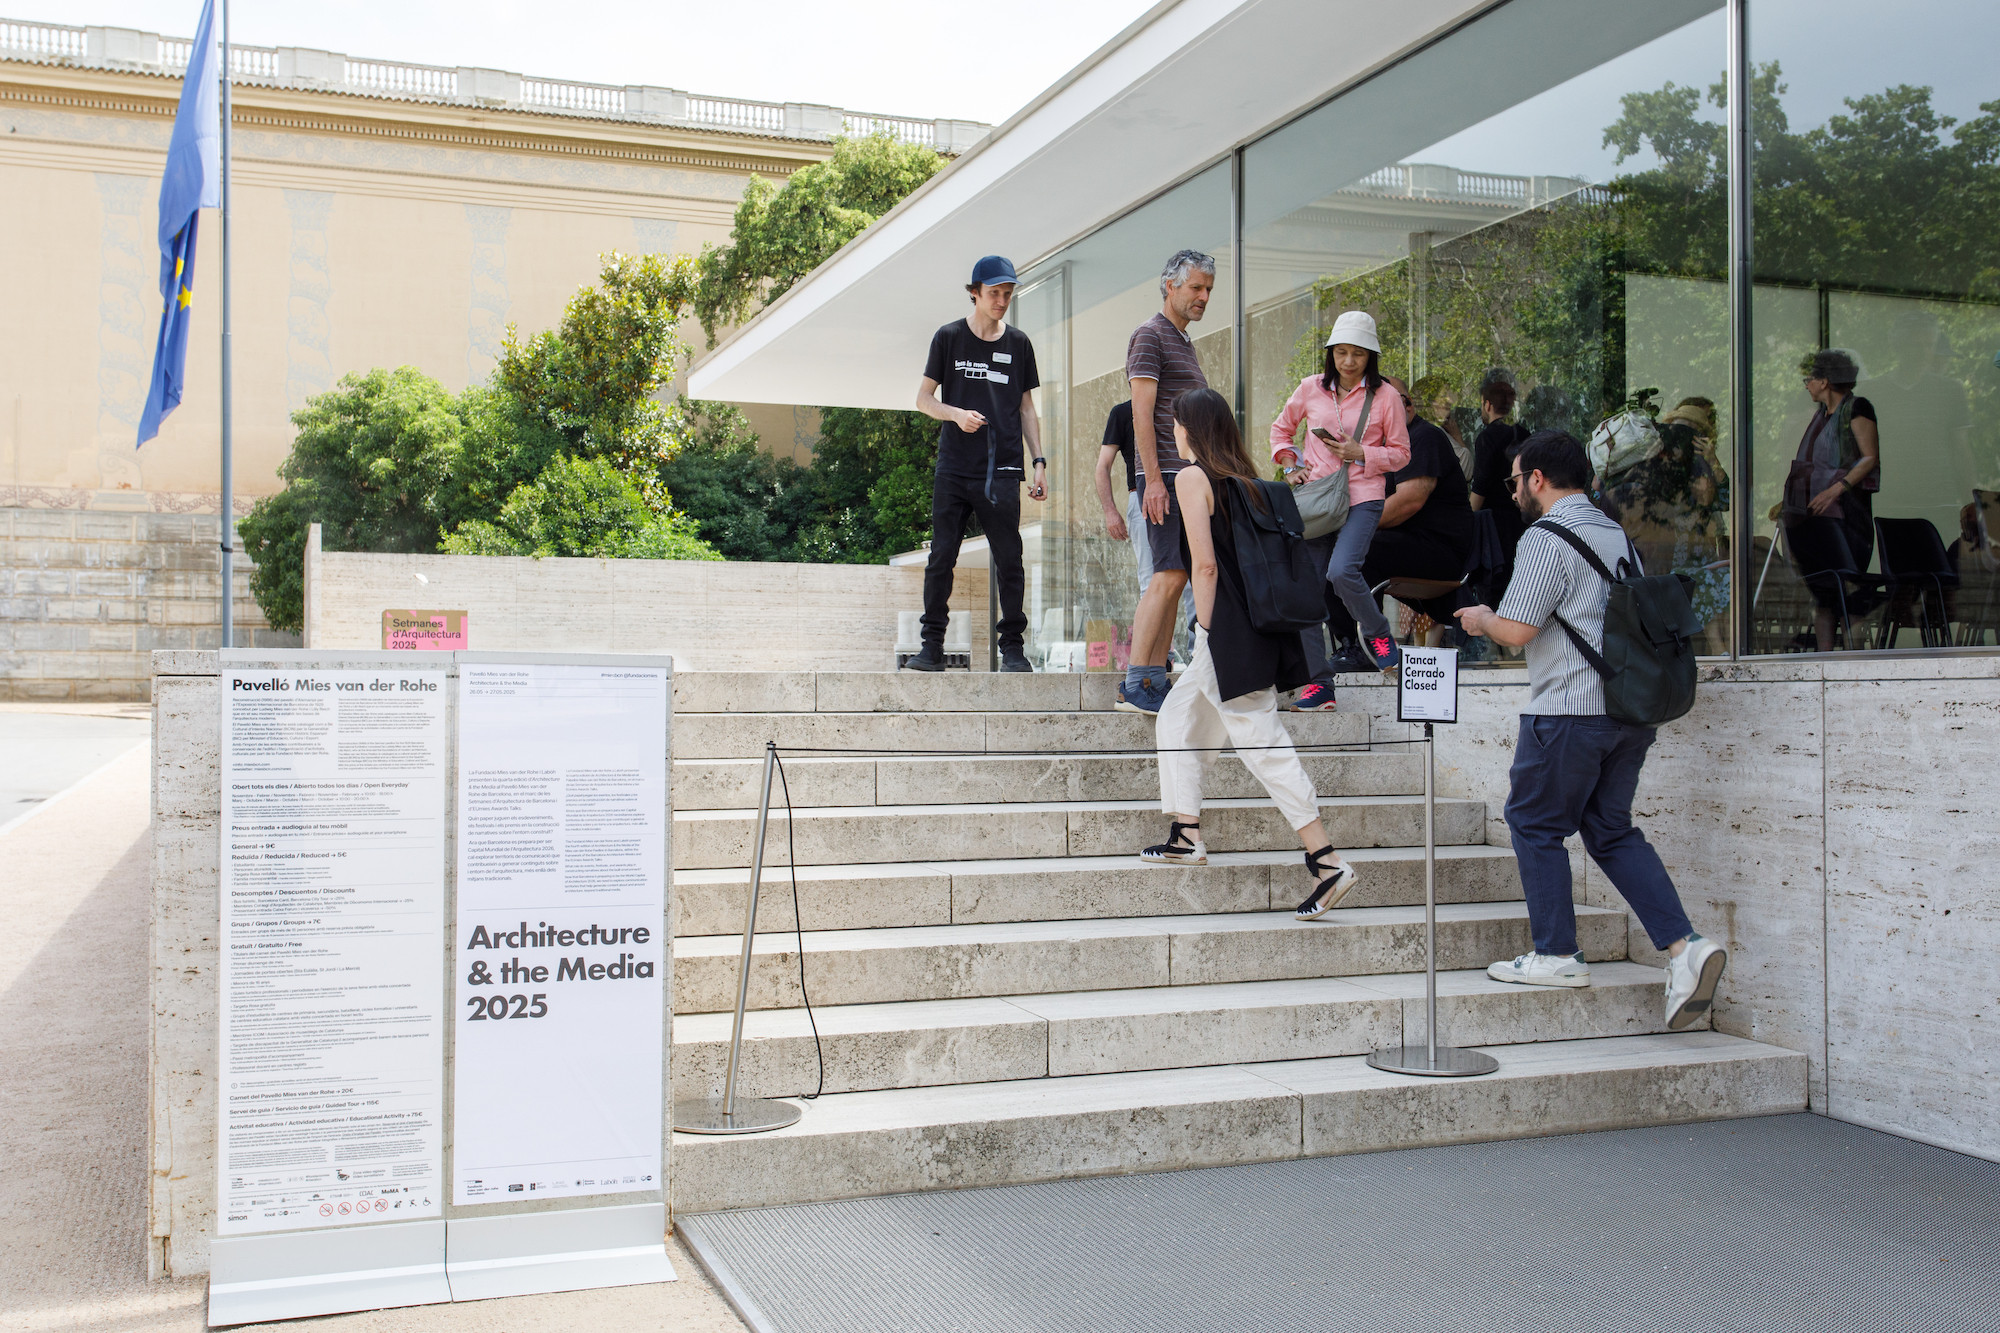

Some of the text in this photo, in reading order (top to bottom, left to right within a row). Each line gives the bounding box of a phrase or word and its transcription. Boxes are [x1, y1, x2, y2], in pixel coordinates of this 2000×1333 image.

[392, 618, 443, 628] Setmanes
[392, 630, 461, 640] d'Arquitectura
[392, 641, 417, 649] 2025
[1405, 654, 1437, 665] Tancat
[1405, 667, 1445, 678] Cerrado
[233, 678, 437, 692] Pavelló Mies van der Rohe
[1405, 679, 1437, 690] Closed
[467, 922, 650, 950] Architecture
[468, 953, 654, 986] & the Media
[468, 994, 548, 1022] 2025
